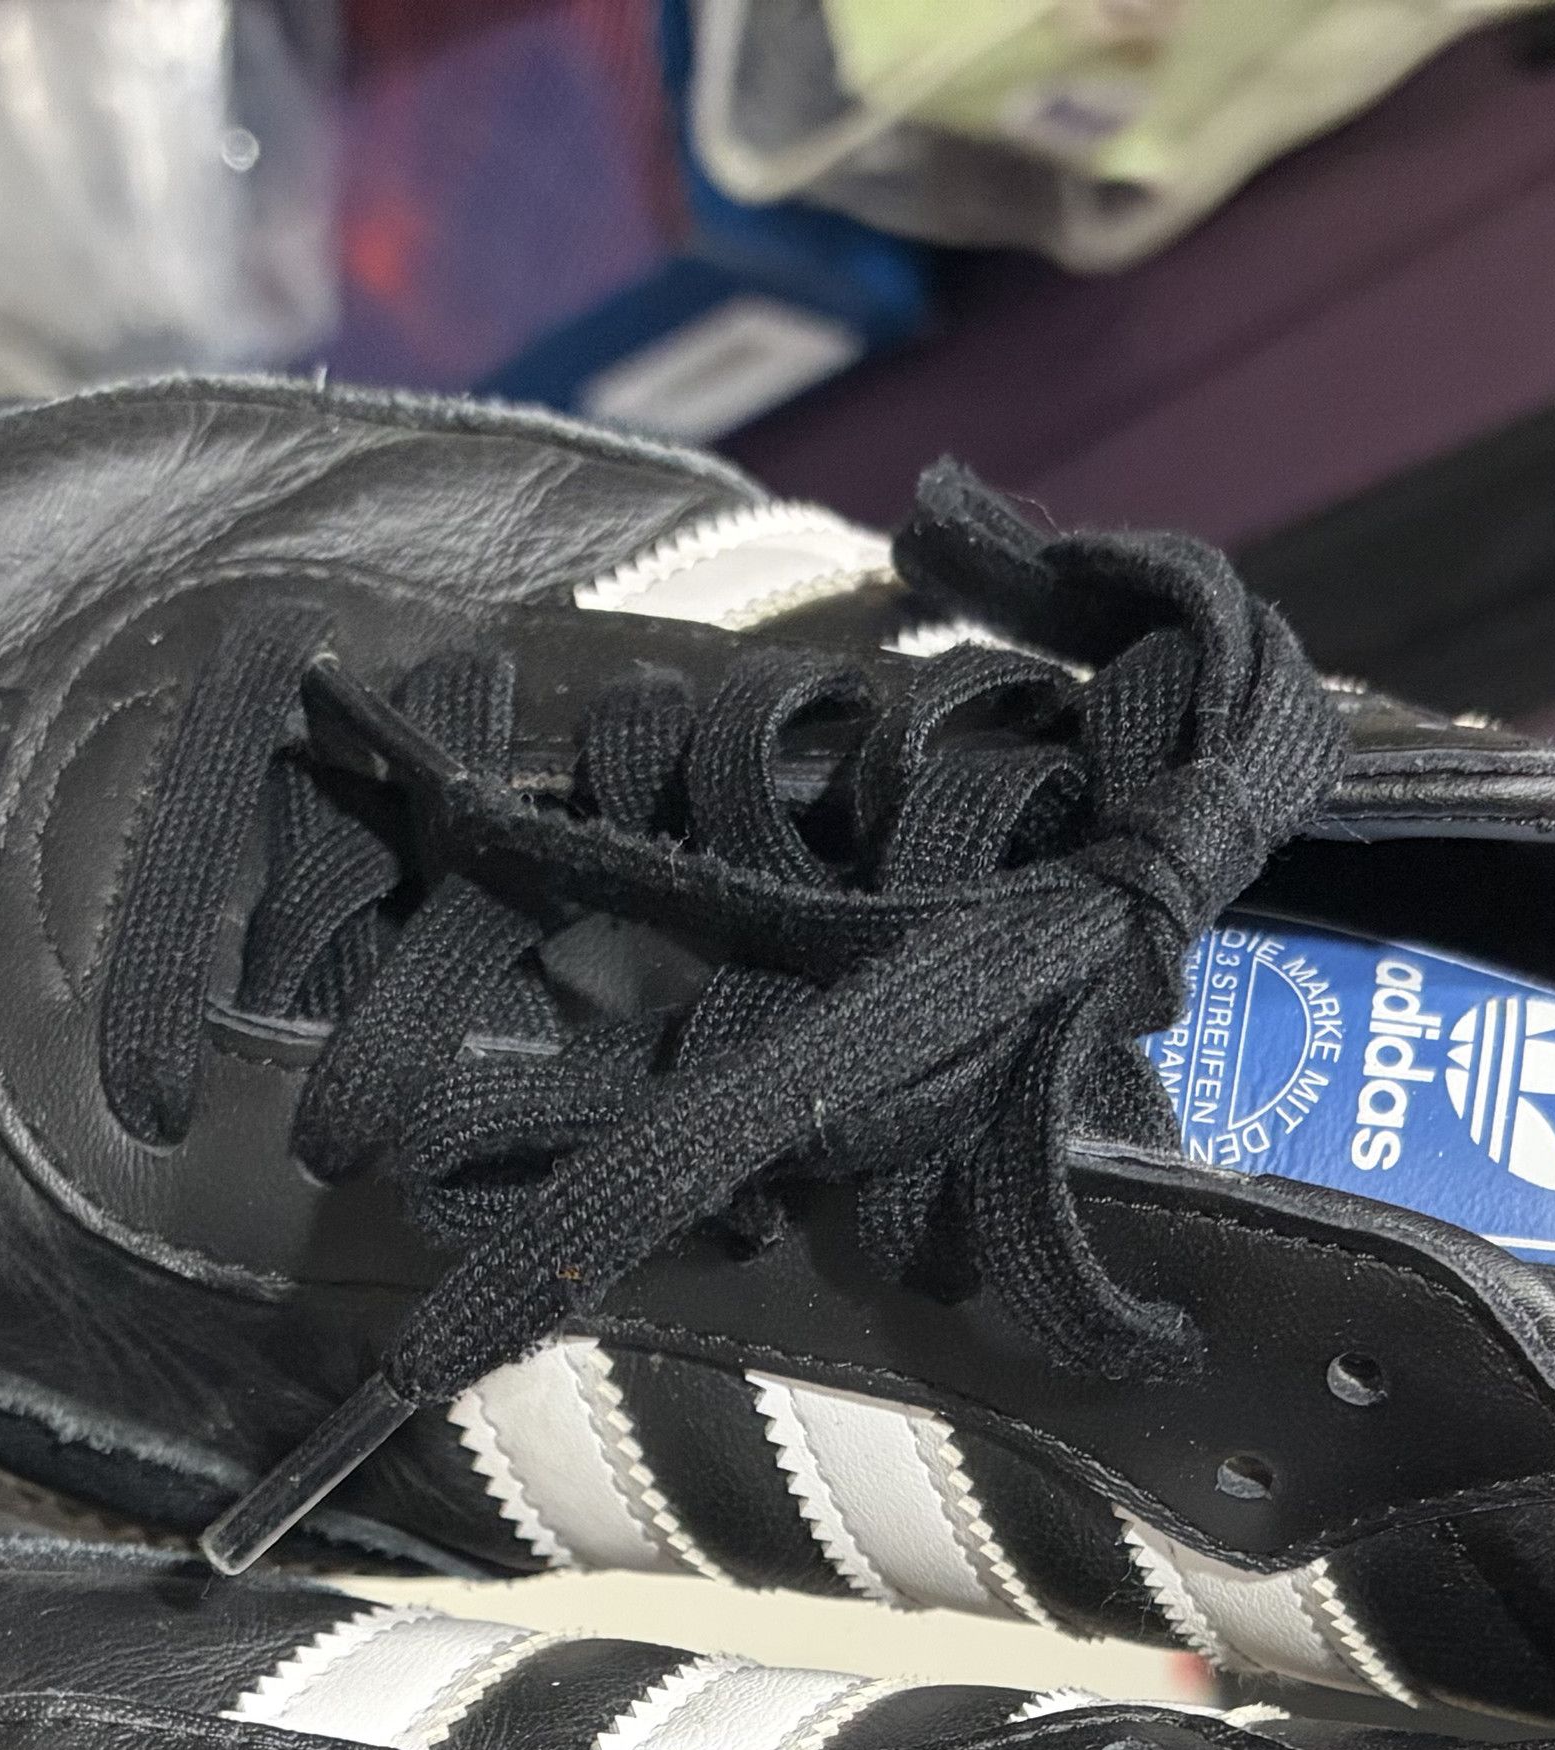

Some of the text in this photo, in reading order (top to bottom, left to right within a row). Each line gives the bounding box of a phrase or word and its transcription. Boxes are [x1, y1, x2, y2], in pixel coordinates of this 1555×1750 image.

[1188, 928, 1344, 1166] DIE MARKE MIT DEN
[1190, 951, 1242, 1125] 3 STREIFEN
[1350, 959, 1442, 1171] adidas
